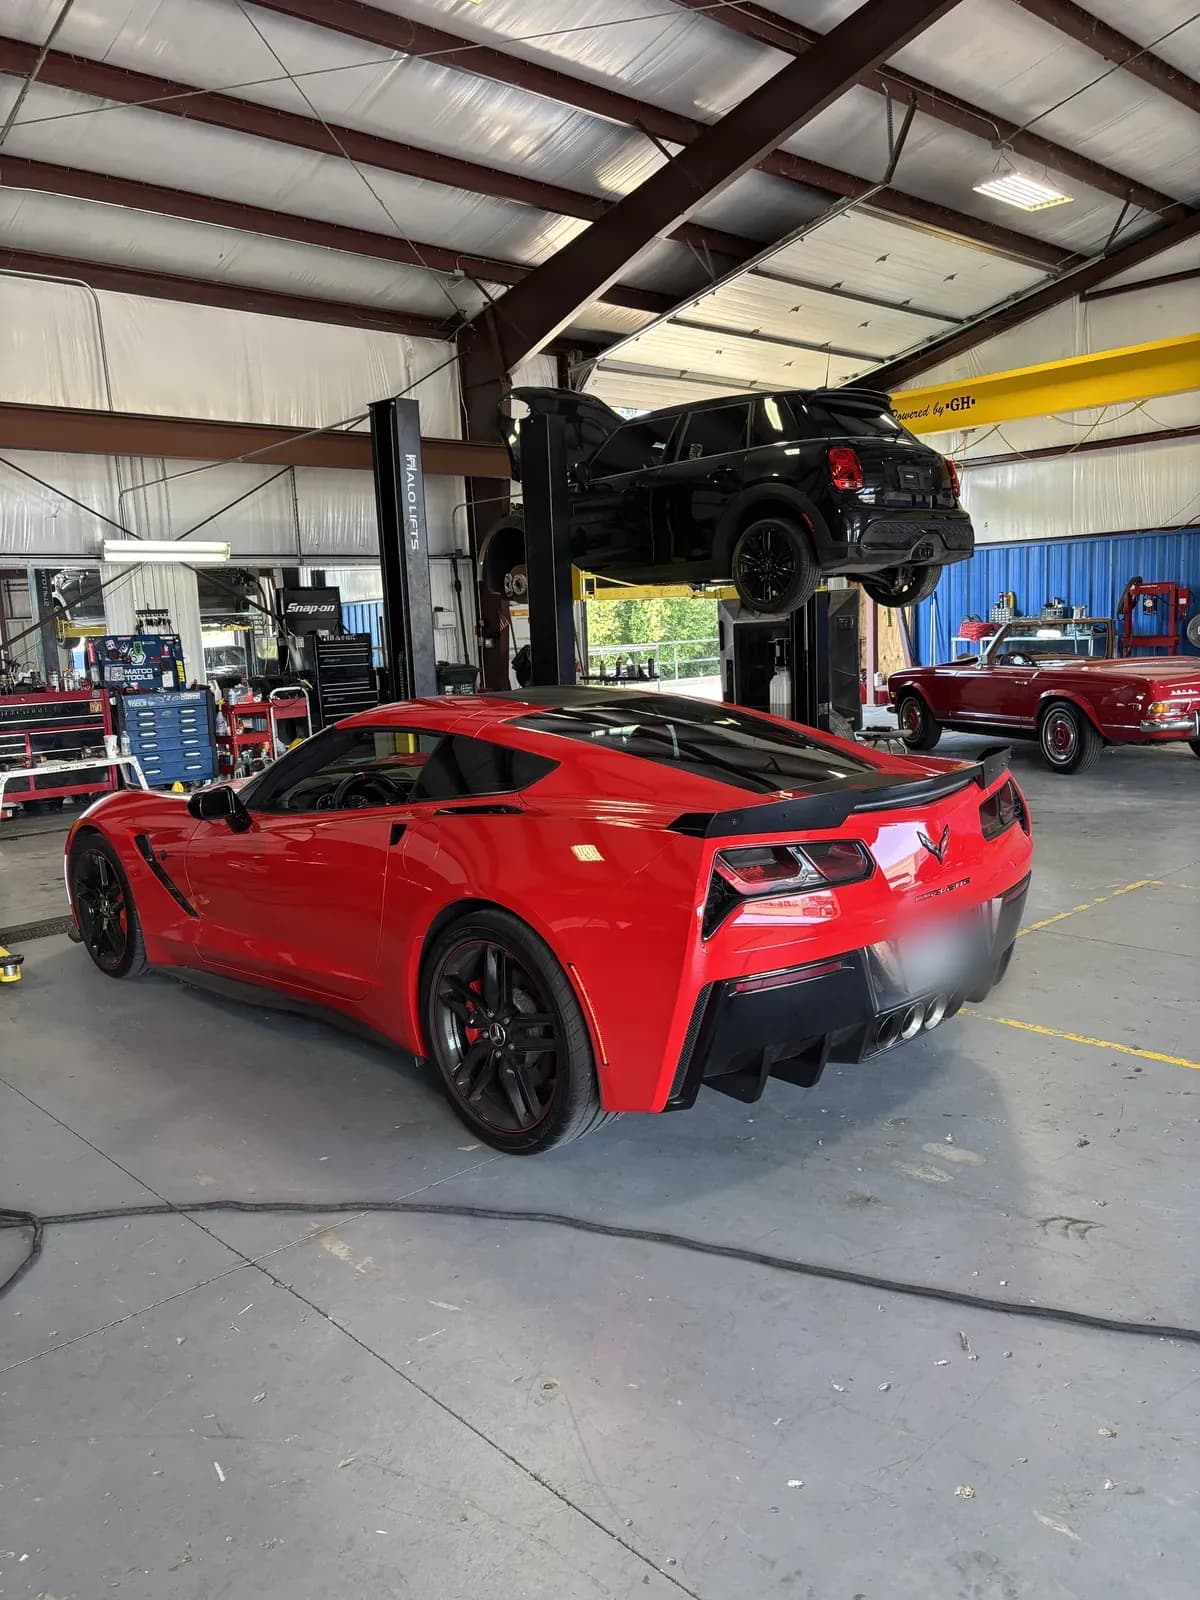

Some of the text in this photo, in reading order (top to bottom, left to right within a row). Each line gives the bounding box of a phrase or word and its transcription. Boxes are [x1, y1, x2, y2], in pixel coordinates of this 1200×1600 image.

[892, 404, 929, 420] Powered
[932, 401, 944, 416] by
[405, 453, 420, 551] HALO LIFTS
[286, 602, 335, 614] Snap-on
